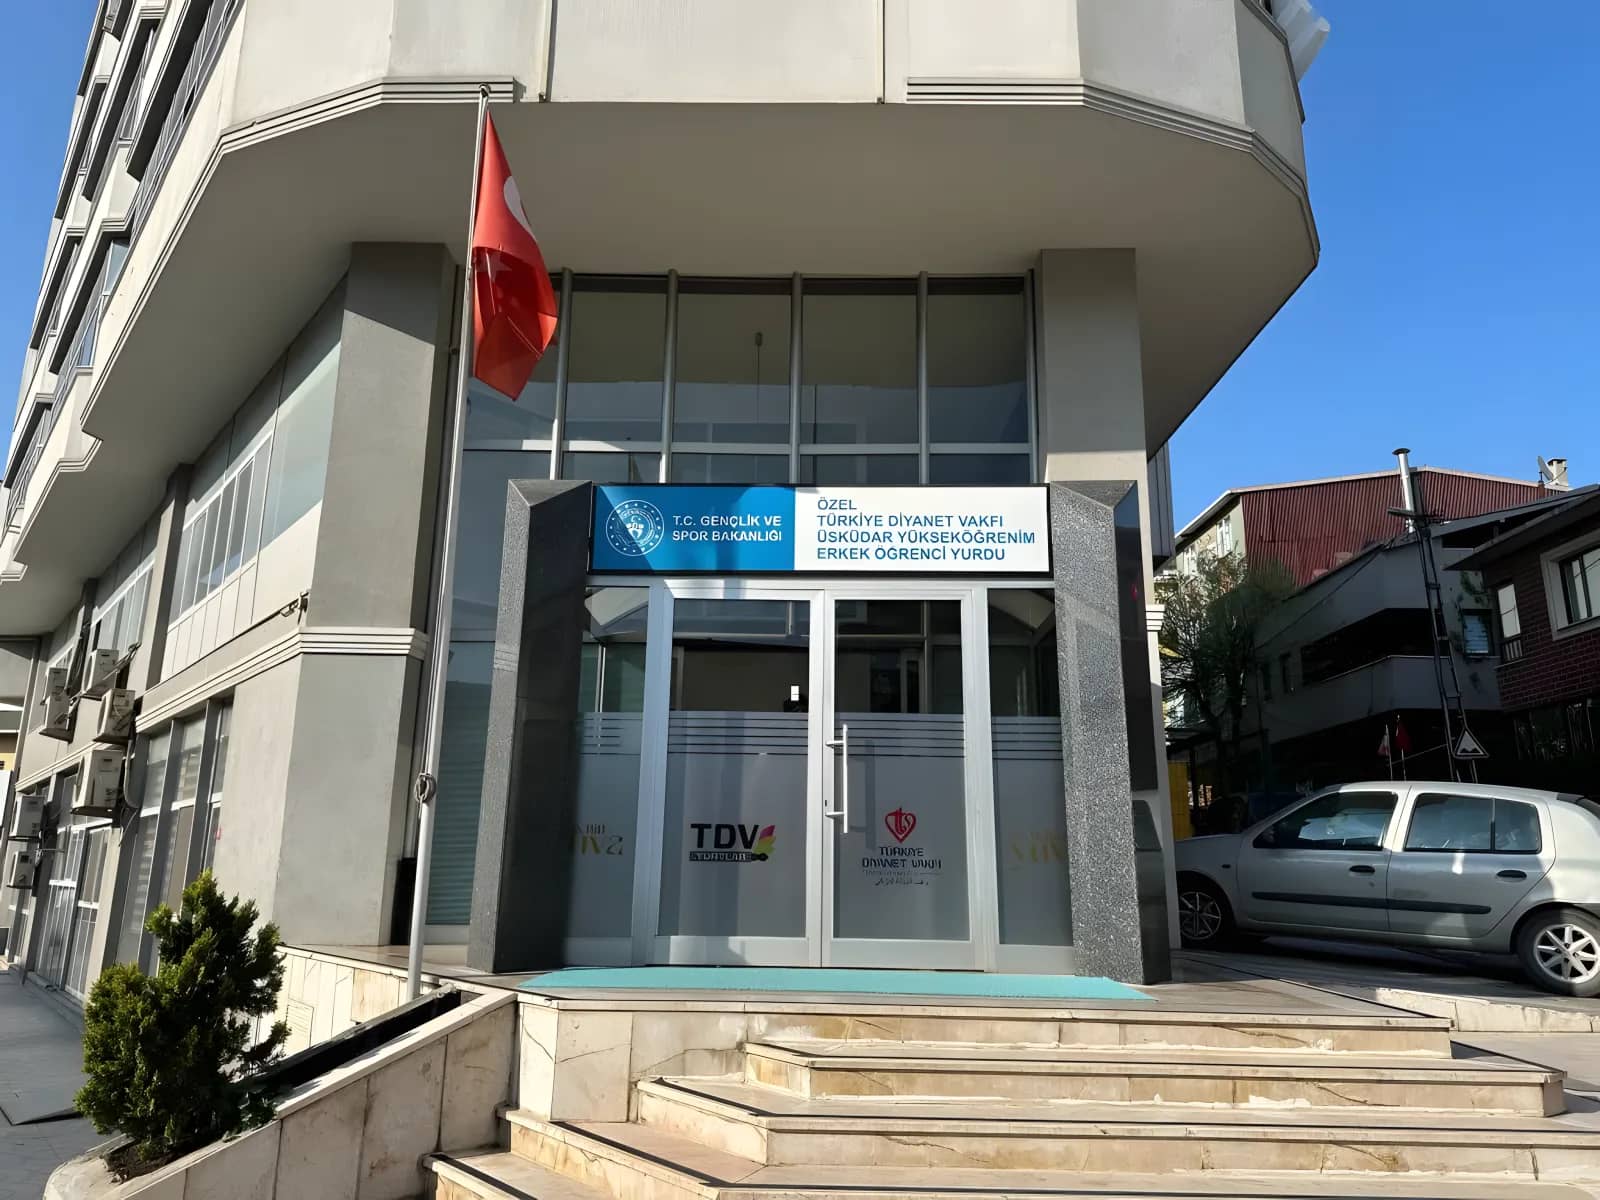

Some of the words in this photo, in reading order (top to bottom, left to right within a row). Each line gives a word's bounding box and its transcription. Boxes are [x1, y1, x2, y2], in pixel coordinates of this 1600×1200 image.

[817, 497, 857, 510] ÖZEL
[672, 515, 695, 527] T.C.
[700, 513, 758, 528] GENÇLİK
[763, 515, 782, 527] VE
[817, 513, 883, 527] TÜRKİYE
[888, 512, 954, 527] DİYANET
[958, 515, 1003, 527] VAKFI
[672, 530, 708, 541] SPOR
[712, 529, 782, 541] BAKANLIĞI
[817, 530, 893, 543] ÜSKÜDAR
[897, 529, 1035, 544] YÜKSEKÖĞRENİM
[817, 548, 870, 559] ERKEK
[874, 545, 946, 560] ÖĞRENCİ
[950, 549, 1005, 560] YURDU
[690, 823, 759, 849] TDV
